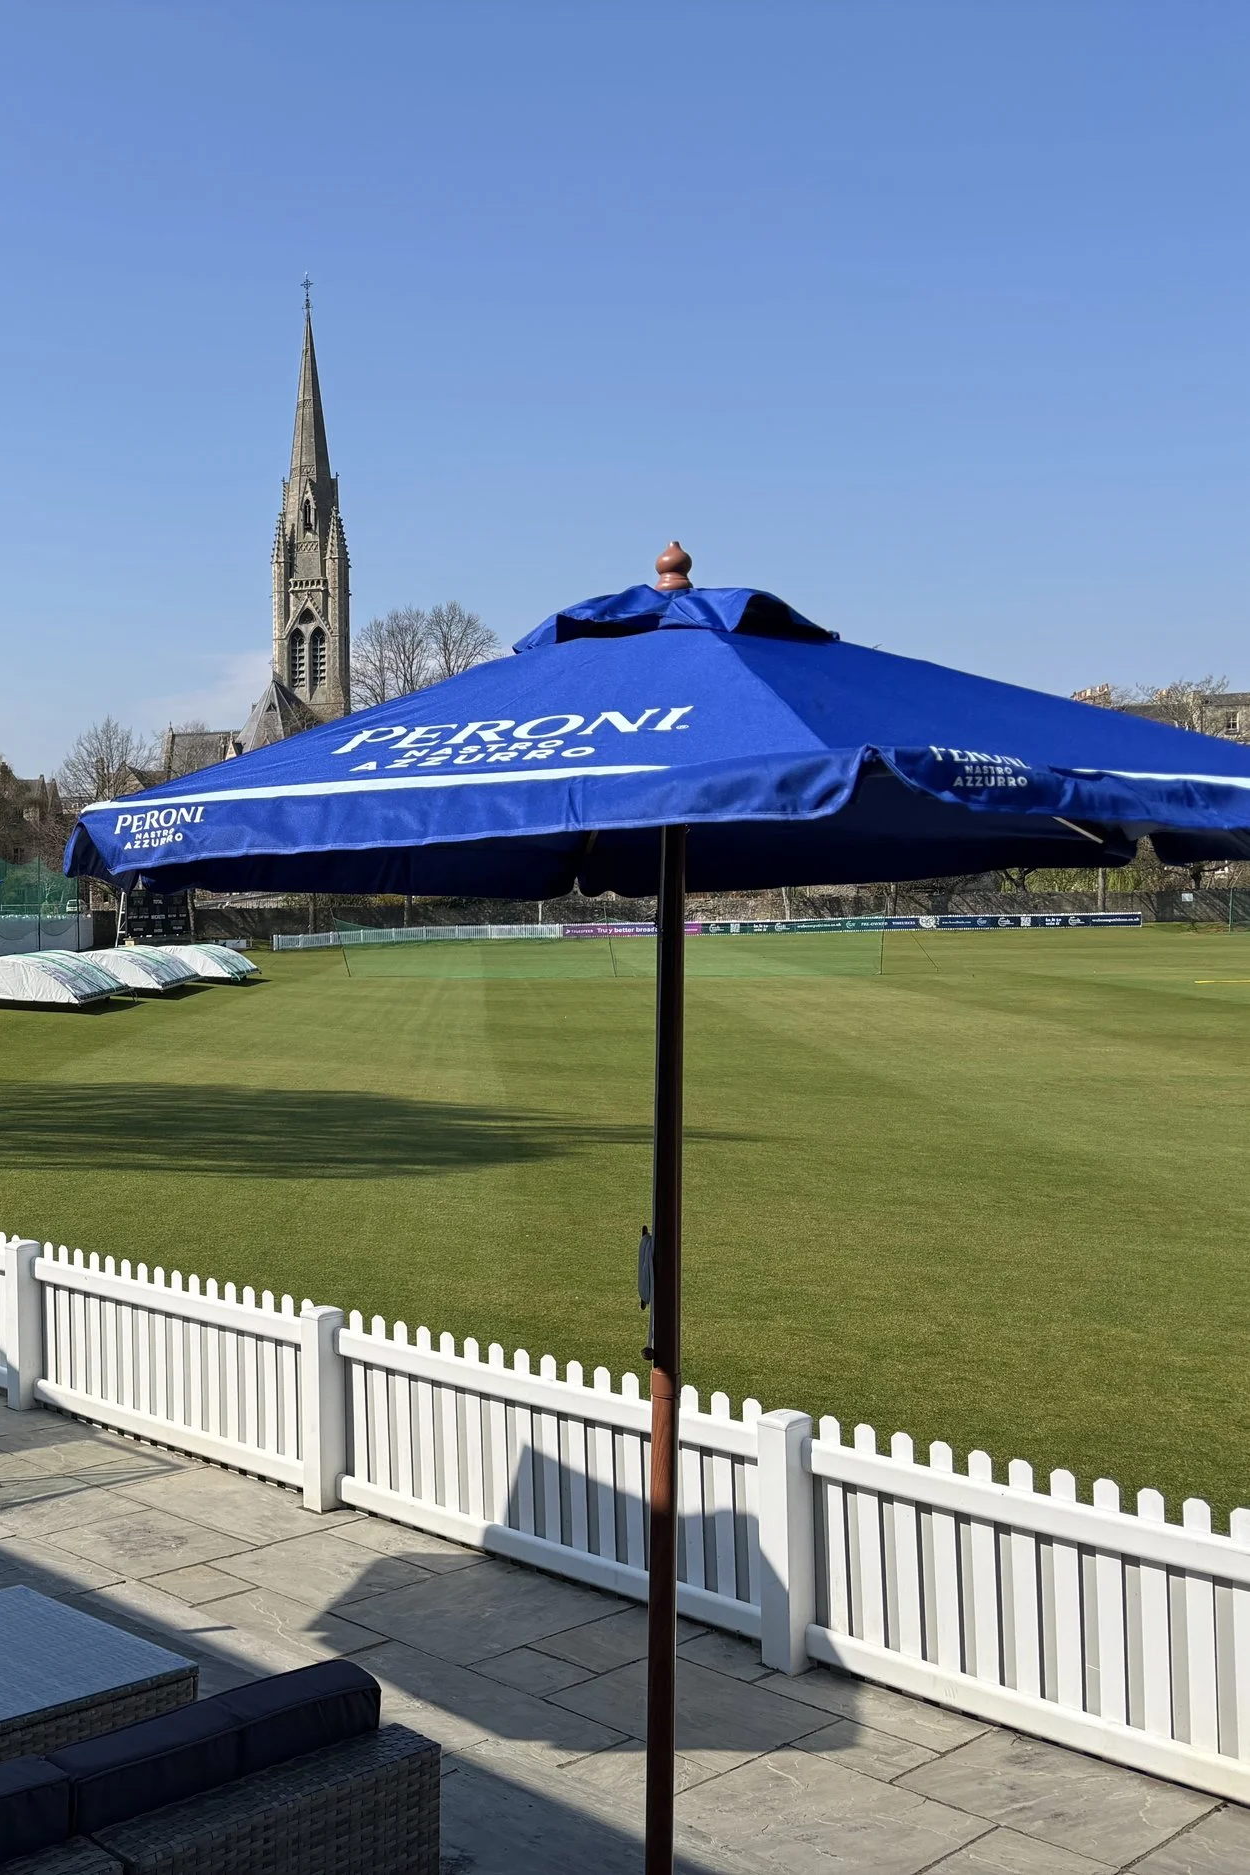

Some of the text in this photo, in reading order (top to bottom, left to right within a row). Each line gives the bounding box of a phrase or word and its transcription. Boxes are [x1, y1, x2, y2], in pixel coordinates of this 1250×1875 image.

[331, 705, 693, 754] PERONI
[402, 740, 564, 758] NASTRO
[349, 746, 595, 771] AZZURRO
[964, 765, 1013, 775] NASTRO
[953, 776, 1028, 787] AZZURRO
[114, 806, 204, 834] PERONI
[124, 833, 183, 850] AZZURRO
[135, 828, 175, 840] NASTRO
